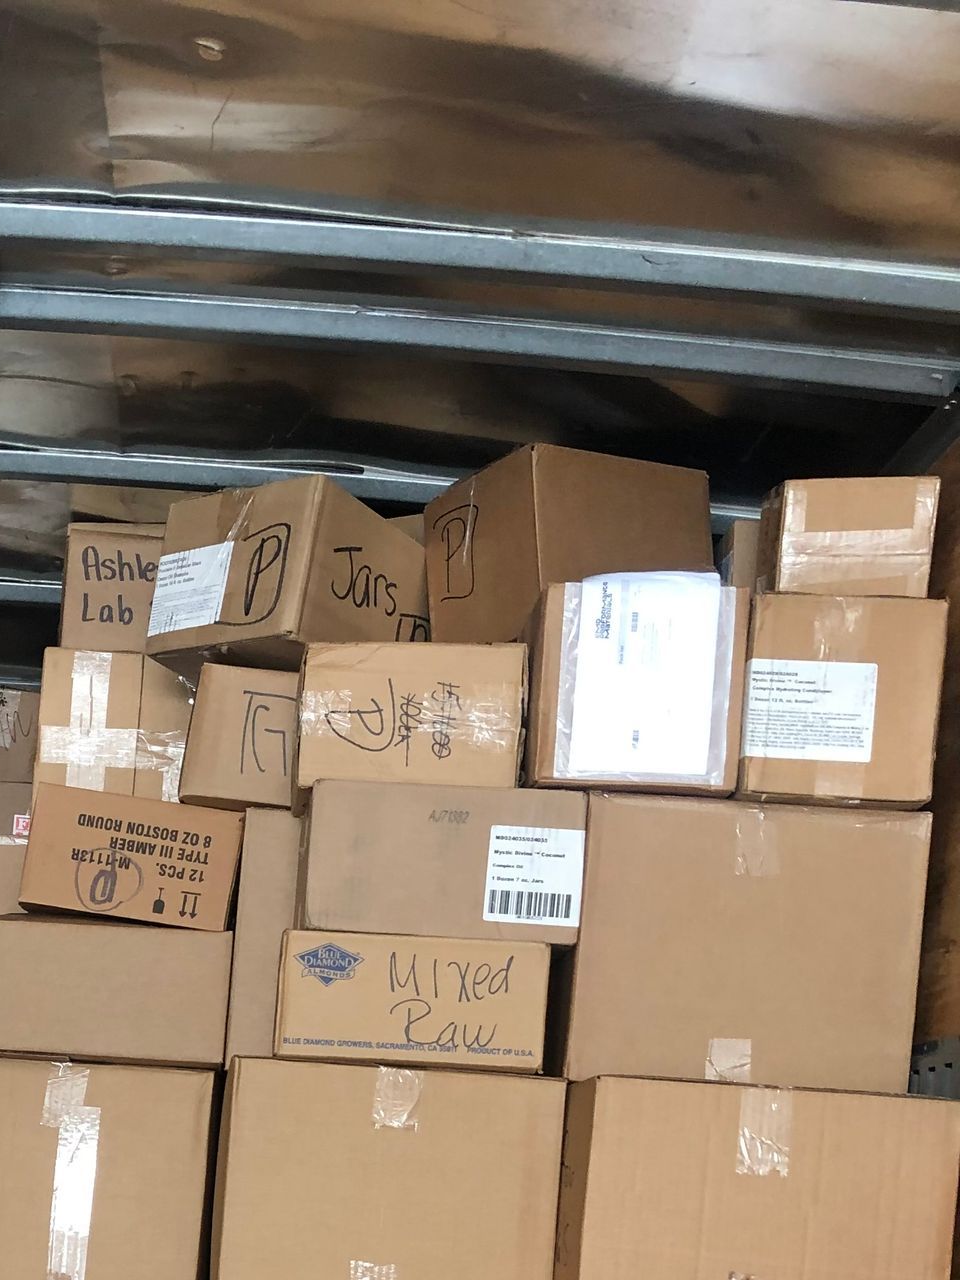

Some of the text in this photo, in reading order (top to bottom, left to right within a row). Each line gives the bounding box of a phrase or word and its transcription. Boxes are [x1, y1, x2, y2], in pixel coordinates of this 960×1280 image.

[82, 545, 159, 582] Ashle
[331, 547, 398, 617] Jars
[82, 592, 134, 625] Lab
[78, 813, 212, 849] 8 OZ BOSTON ROUND
[109, 836, 209, 865] TYPE III AMBER
[155, 862, 205, 883] 12 PCS.
[304, 954, 355, 968] DIAMOND
[318, 948, 341, 959] BLUE
[307, 967, 351, 978] ALMONDS
[390, 998, 497, 1049] Raw
[283, 1037, 302, 1046] BLUE
[303, 1038, 335, 1047] DIAMOND
[427, 1044, 437, 1052] CA
[466, 1045, 501, 1056] PRODUCT
